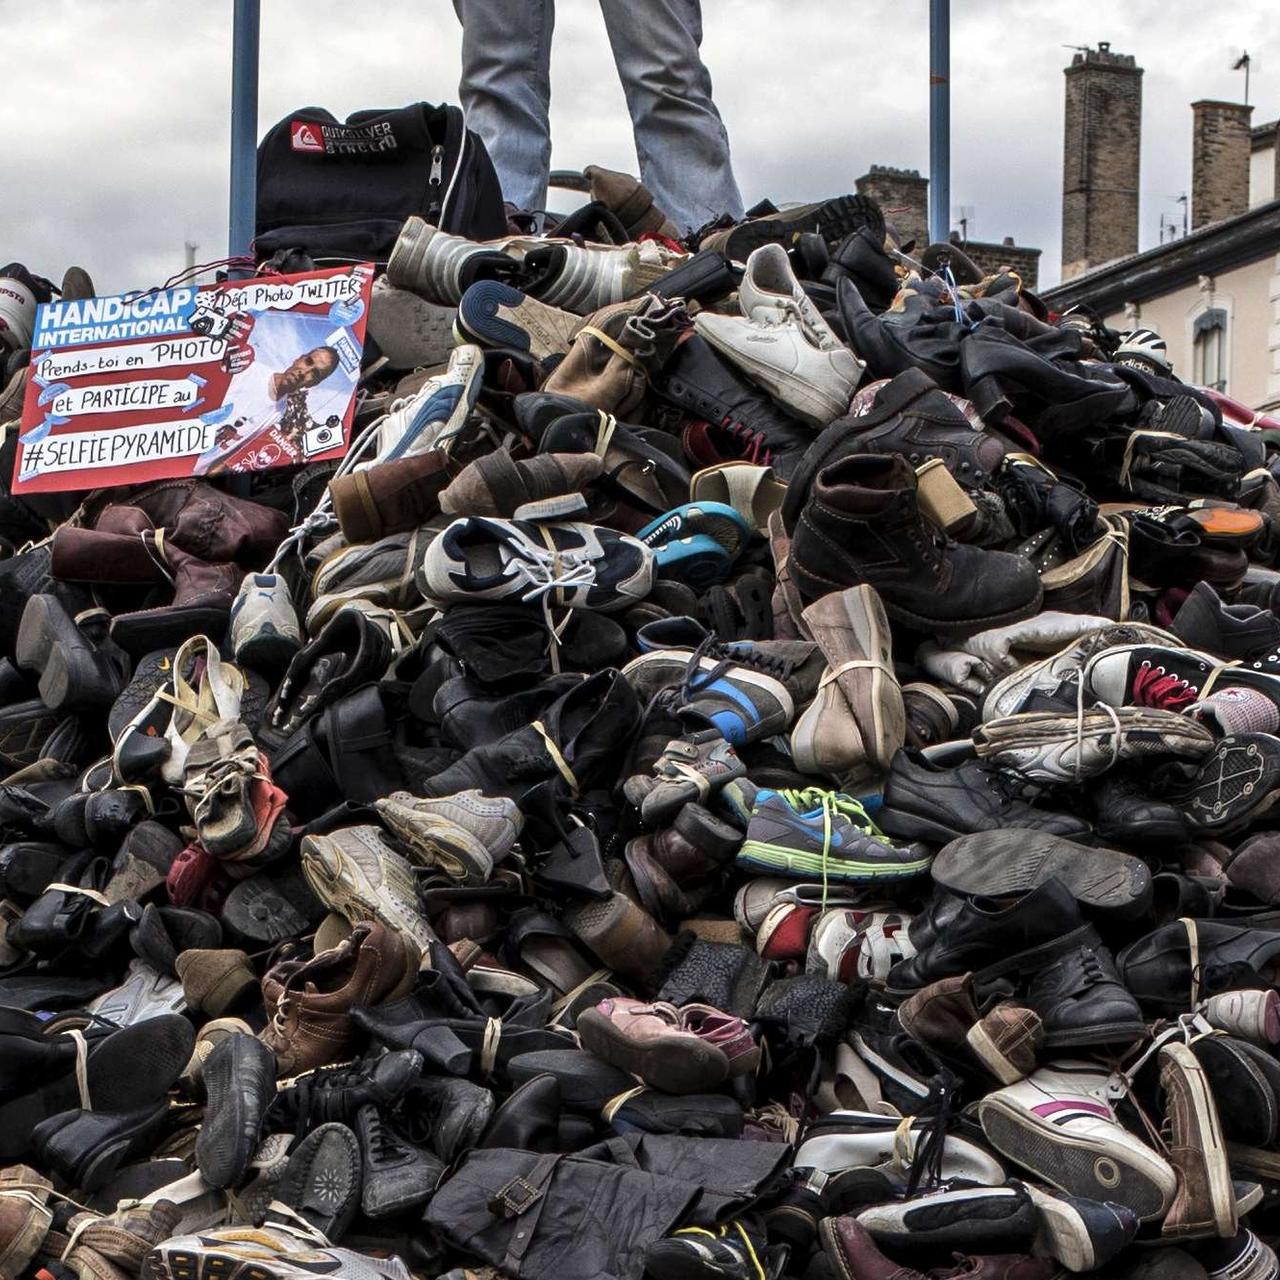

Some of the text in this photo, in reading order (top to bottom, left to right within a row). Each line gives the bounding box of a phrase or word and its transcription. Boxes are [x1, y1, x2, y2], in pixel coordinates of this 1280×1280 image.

[41, 288, 192, 330] HANDICAP
[220, 279, 357, 311] Défi Photo TWITTER
[38, 316, 188, 347] INTERNATIONAL
[41, 356, 120, 378] Prends-toi
[126, 355, 144, 367] en
[150, 338, 224, 363] PHOTO
[55, 383, 192, 413] et PARTICIPE au
[23, 425, 213, 472] #SELFIEPYRAMIDE
